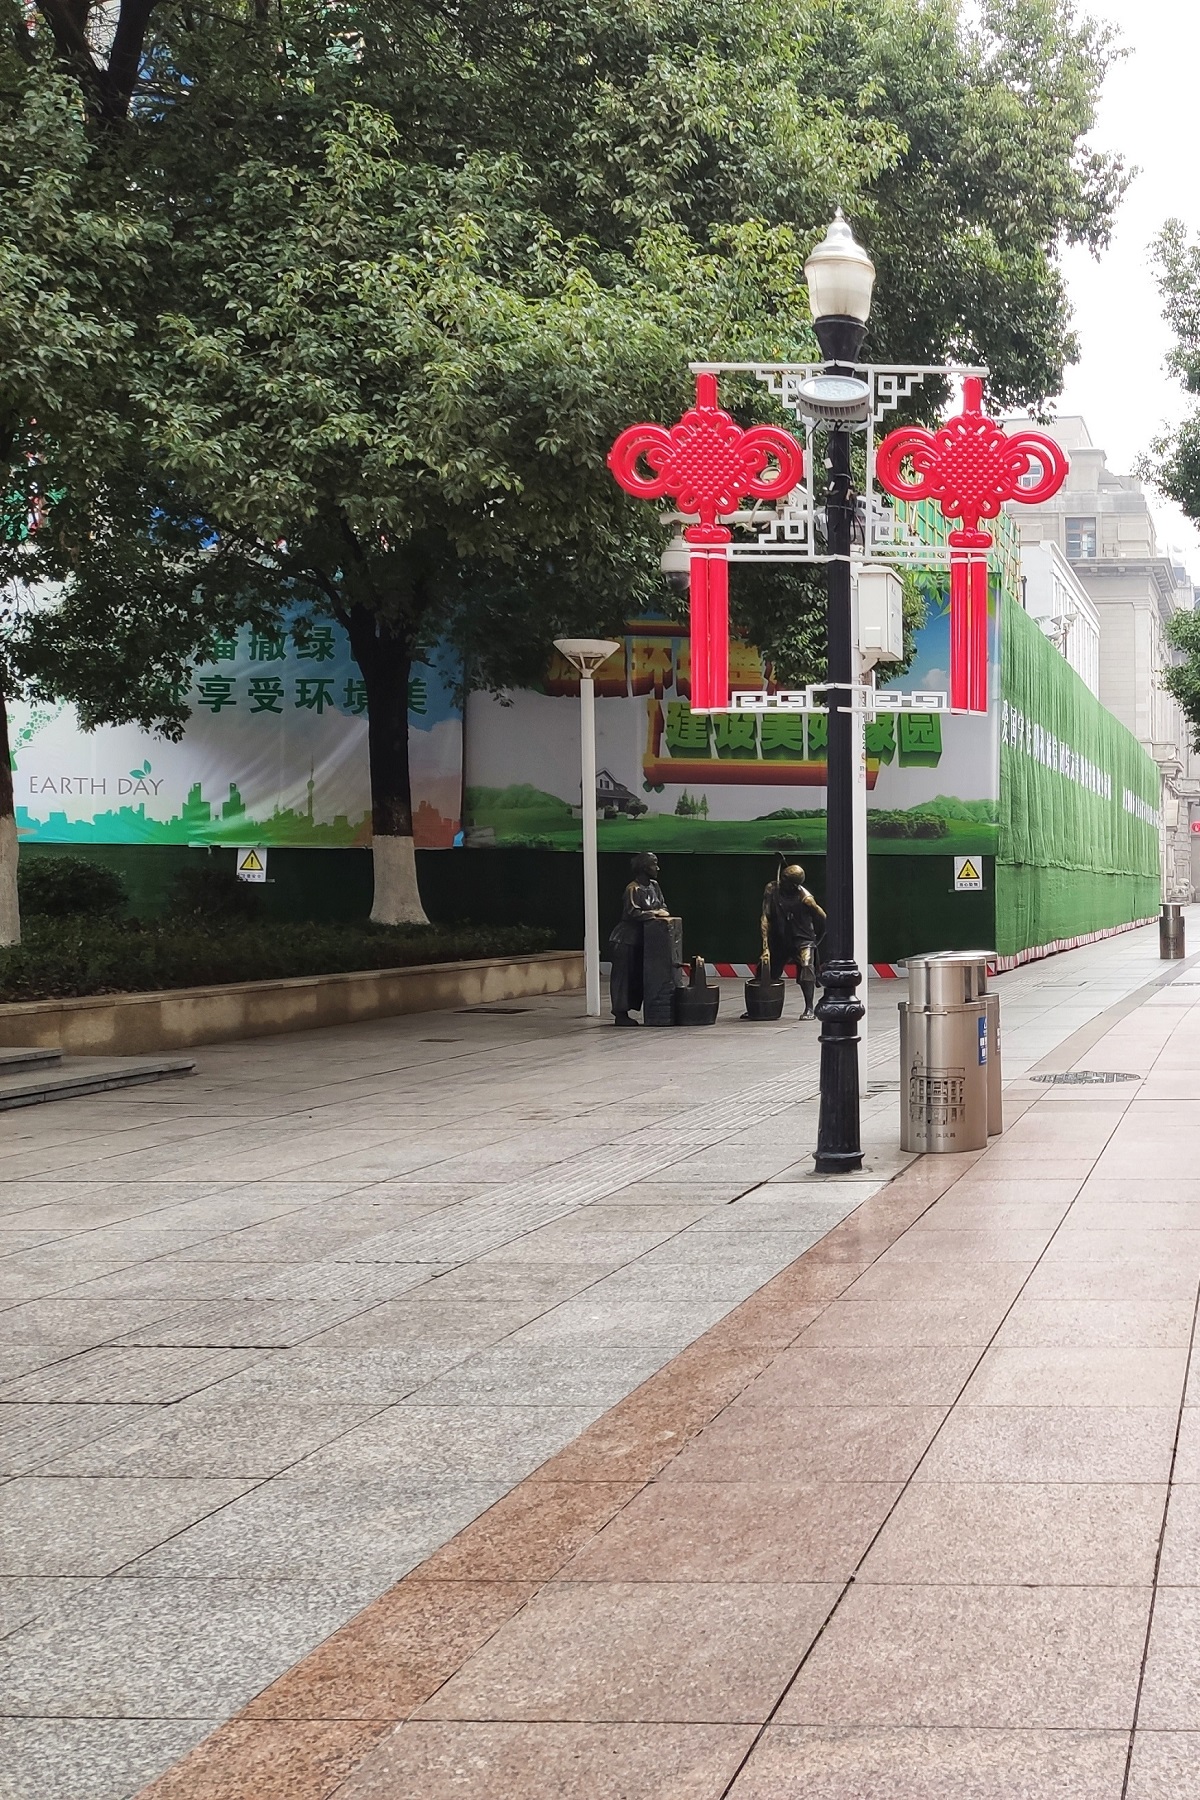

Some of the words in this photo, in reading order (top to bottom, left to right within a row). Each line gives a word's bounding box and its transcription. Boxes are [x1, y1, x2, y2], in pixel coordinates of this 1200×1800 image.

[160, 675, 428, 714] 享受环境美
[29, 775, 106, 795] EARTH
[118, 777, 164, 796] DAY
